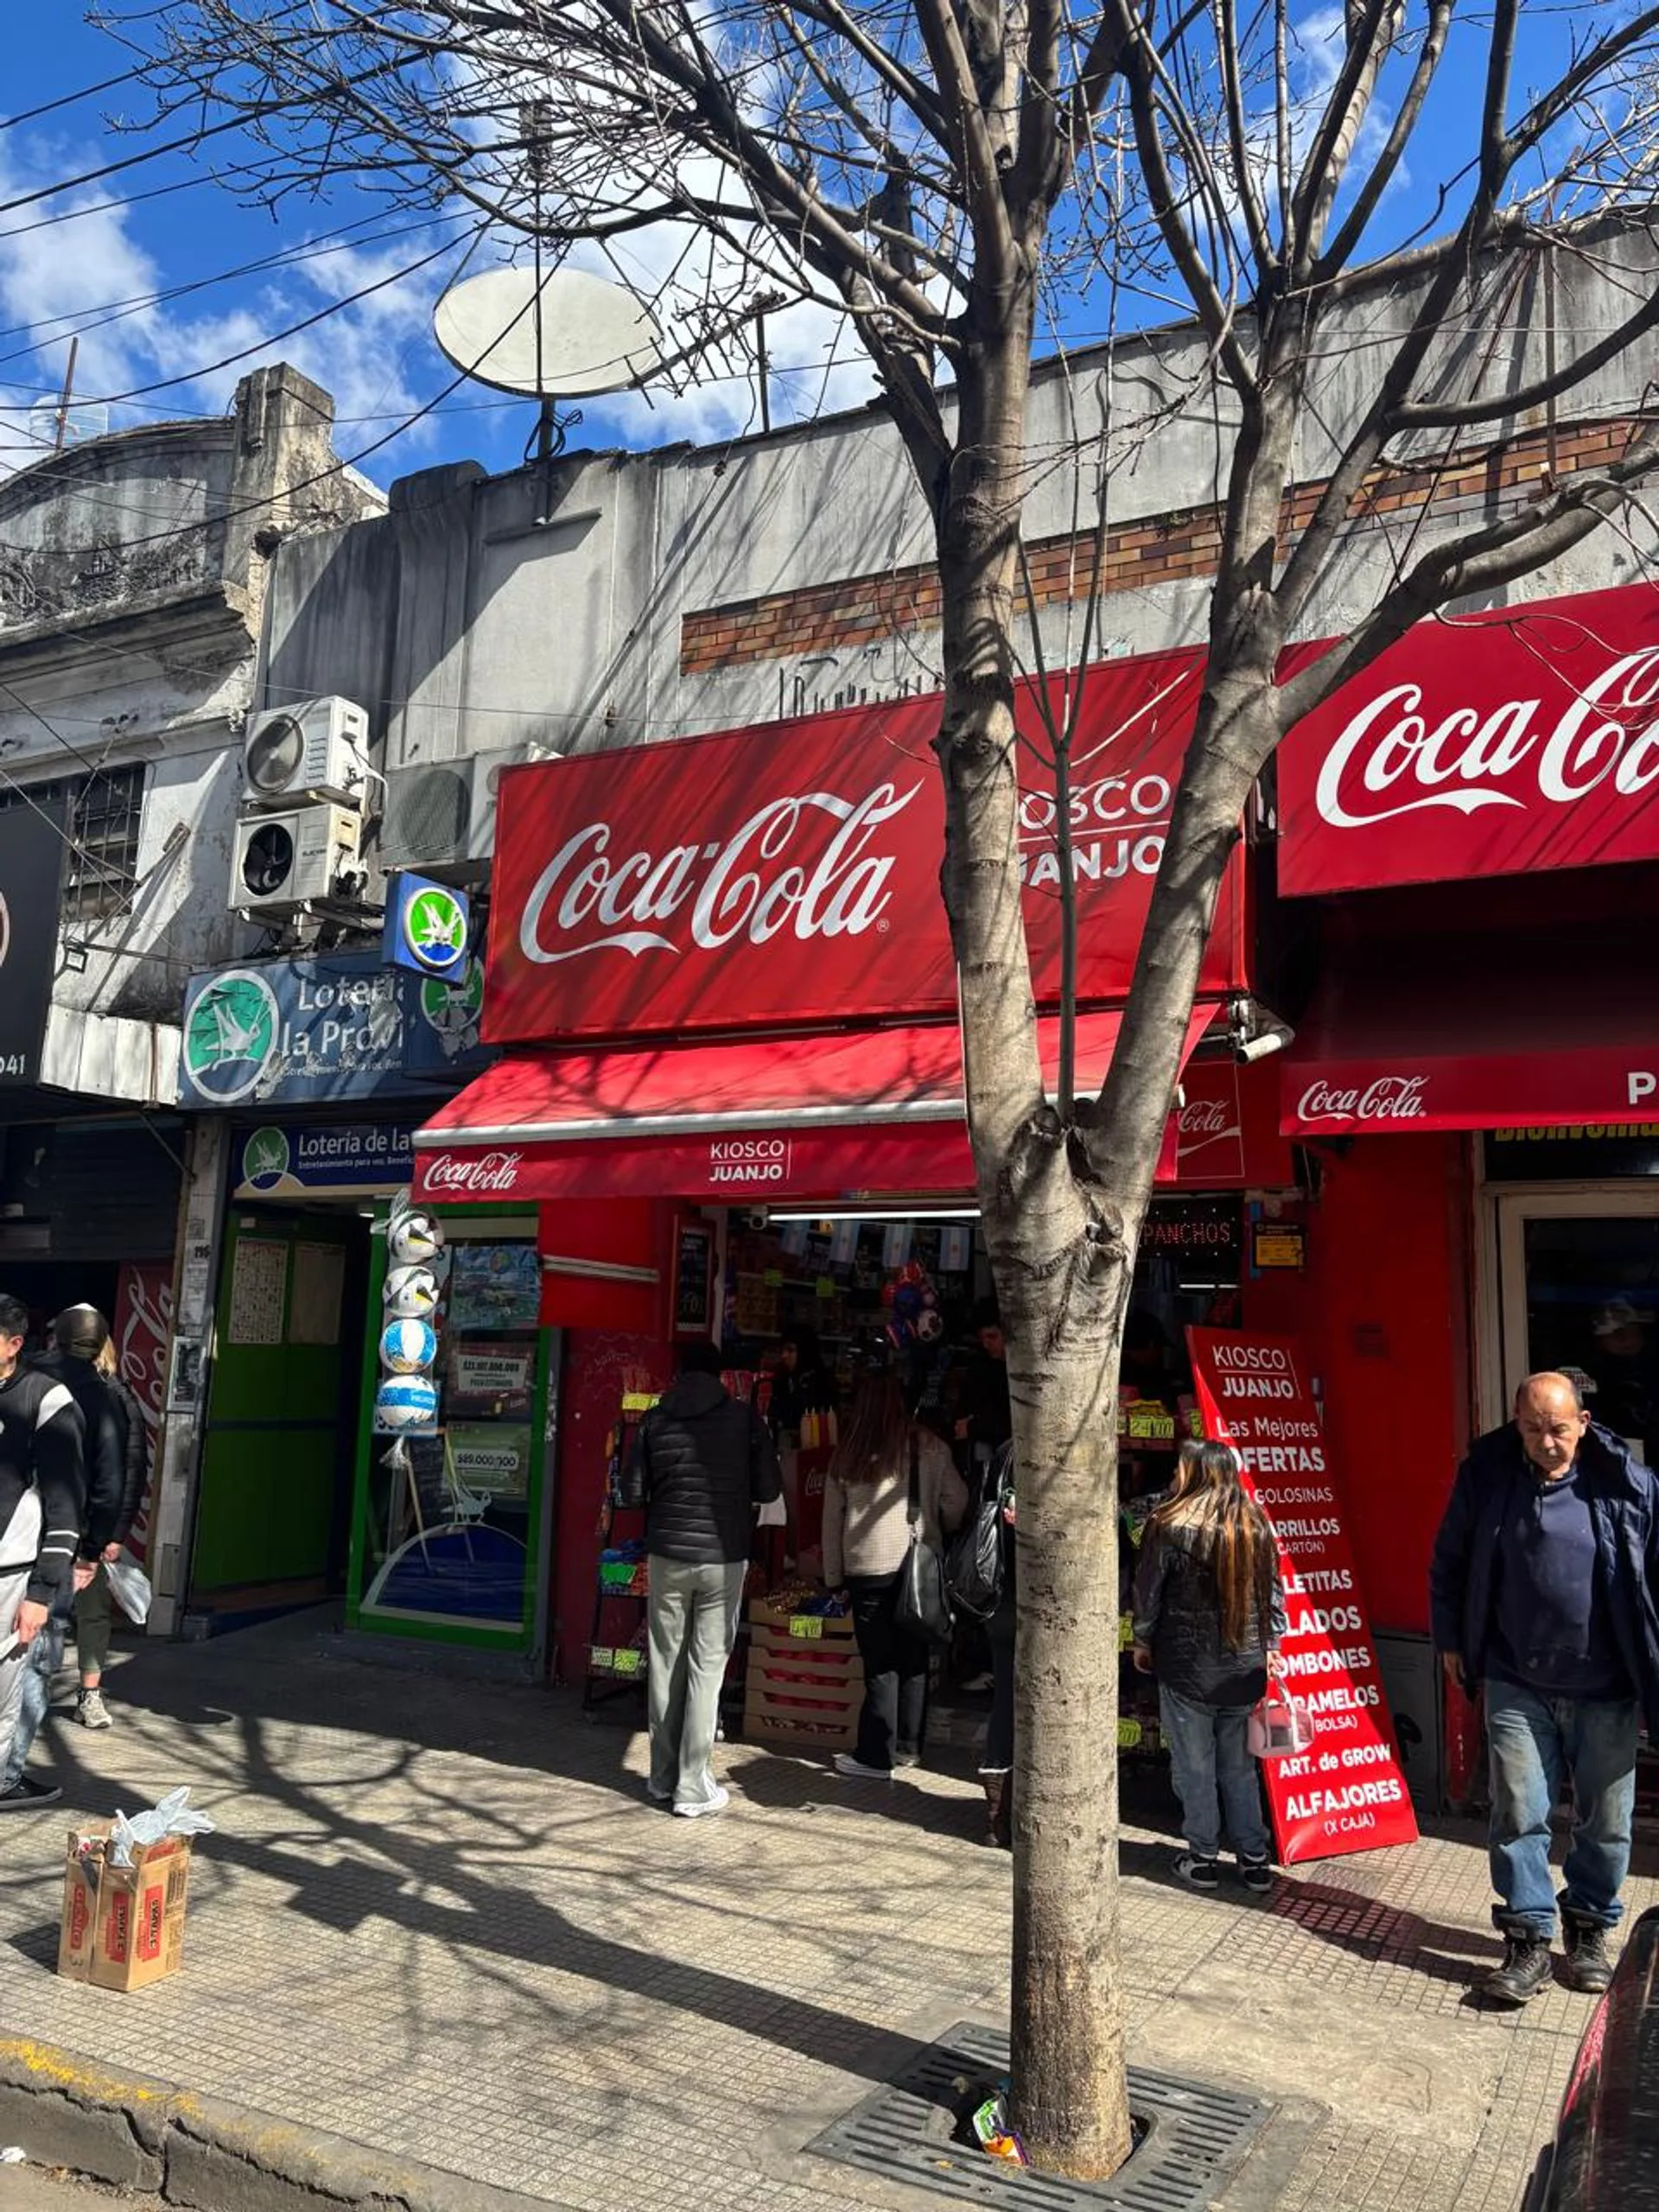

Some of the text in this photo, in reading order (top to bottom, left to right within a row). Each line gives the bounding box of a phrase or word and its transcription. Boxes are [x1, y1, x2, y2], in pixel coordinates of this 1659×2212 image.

[299, 1127, 410, 1156] Lotería de la
[711, 1141, 784, 1159] KIOSCO
[709, 1165, 782, 1181] JUANJO
[1144, 1223, 1230, 1245] PANCHOS
[1212, 1345, 1286, 1370] KIOSCO
[1223, 1377, 1294, 1398] JUANJO
[1216, 1416, 1319, 1440] Las Mejores
[1255, 1486, 1333, 1504] GOLOSINAS
[1314, 1714, 1357, 1732] BOLSA)
[1279, 1744, 1391, 1778] ART. de GROW
[1286, 1778, 1402, 1821] ALFAJORES
[1324, 1812, 1376, 1836] (X CAJA)
